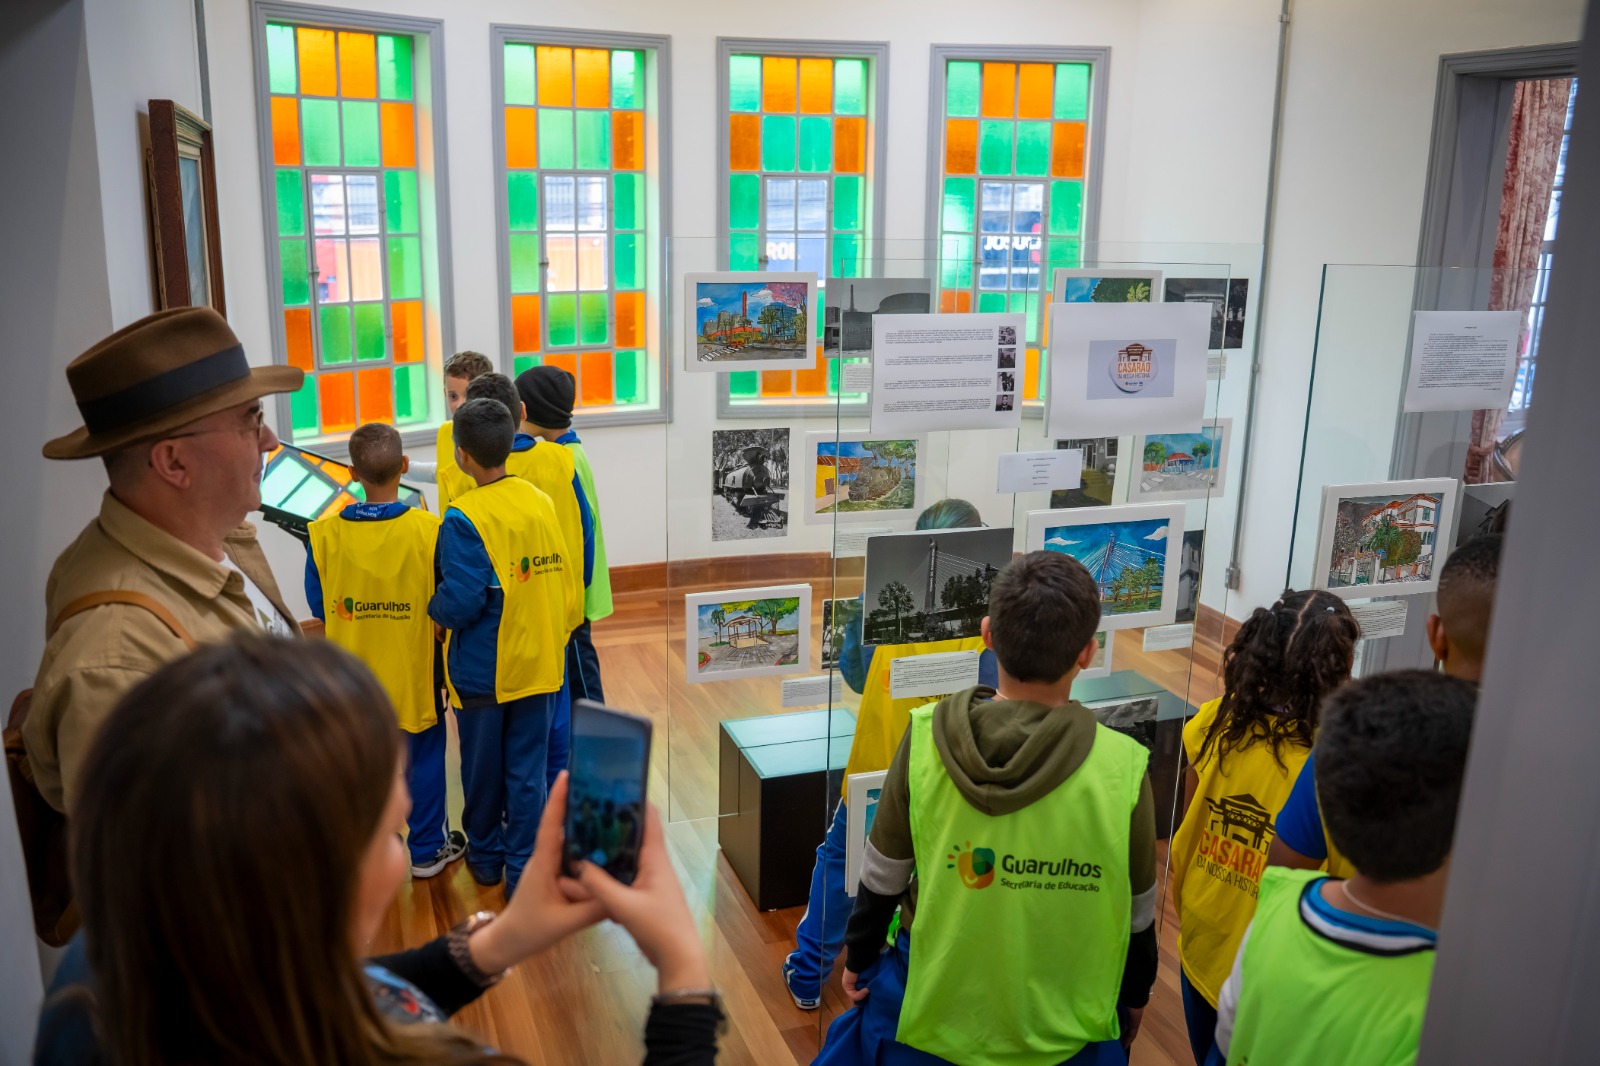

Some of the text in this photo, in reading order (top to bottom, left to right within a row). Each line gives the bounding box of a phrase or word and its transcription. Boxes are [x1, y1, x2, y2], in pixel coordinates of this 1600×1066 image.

[355, 601, 411, 612] Guarulhos
[1001, 854, 1102, 879] Guarulhos
[1206, 860, 1232, 885] NOSSA
[1001, 878, 1100, 893] Secretaria de Educação
